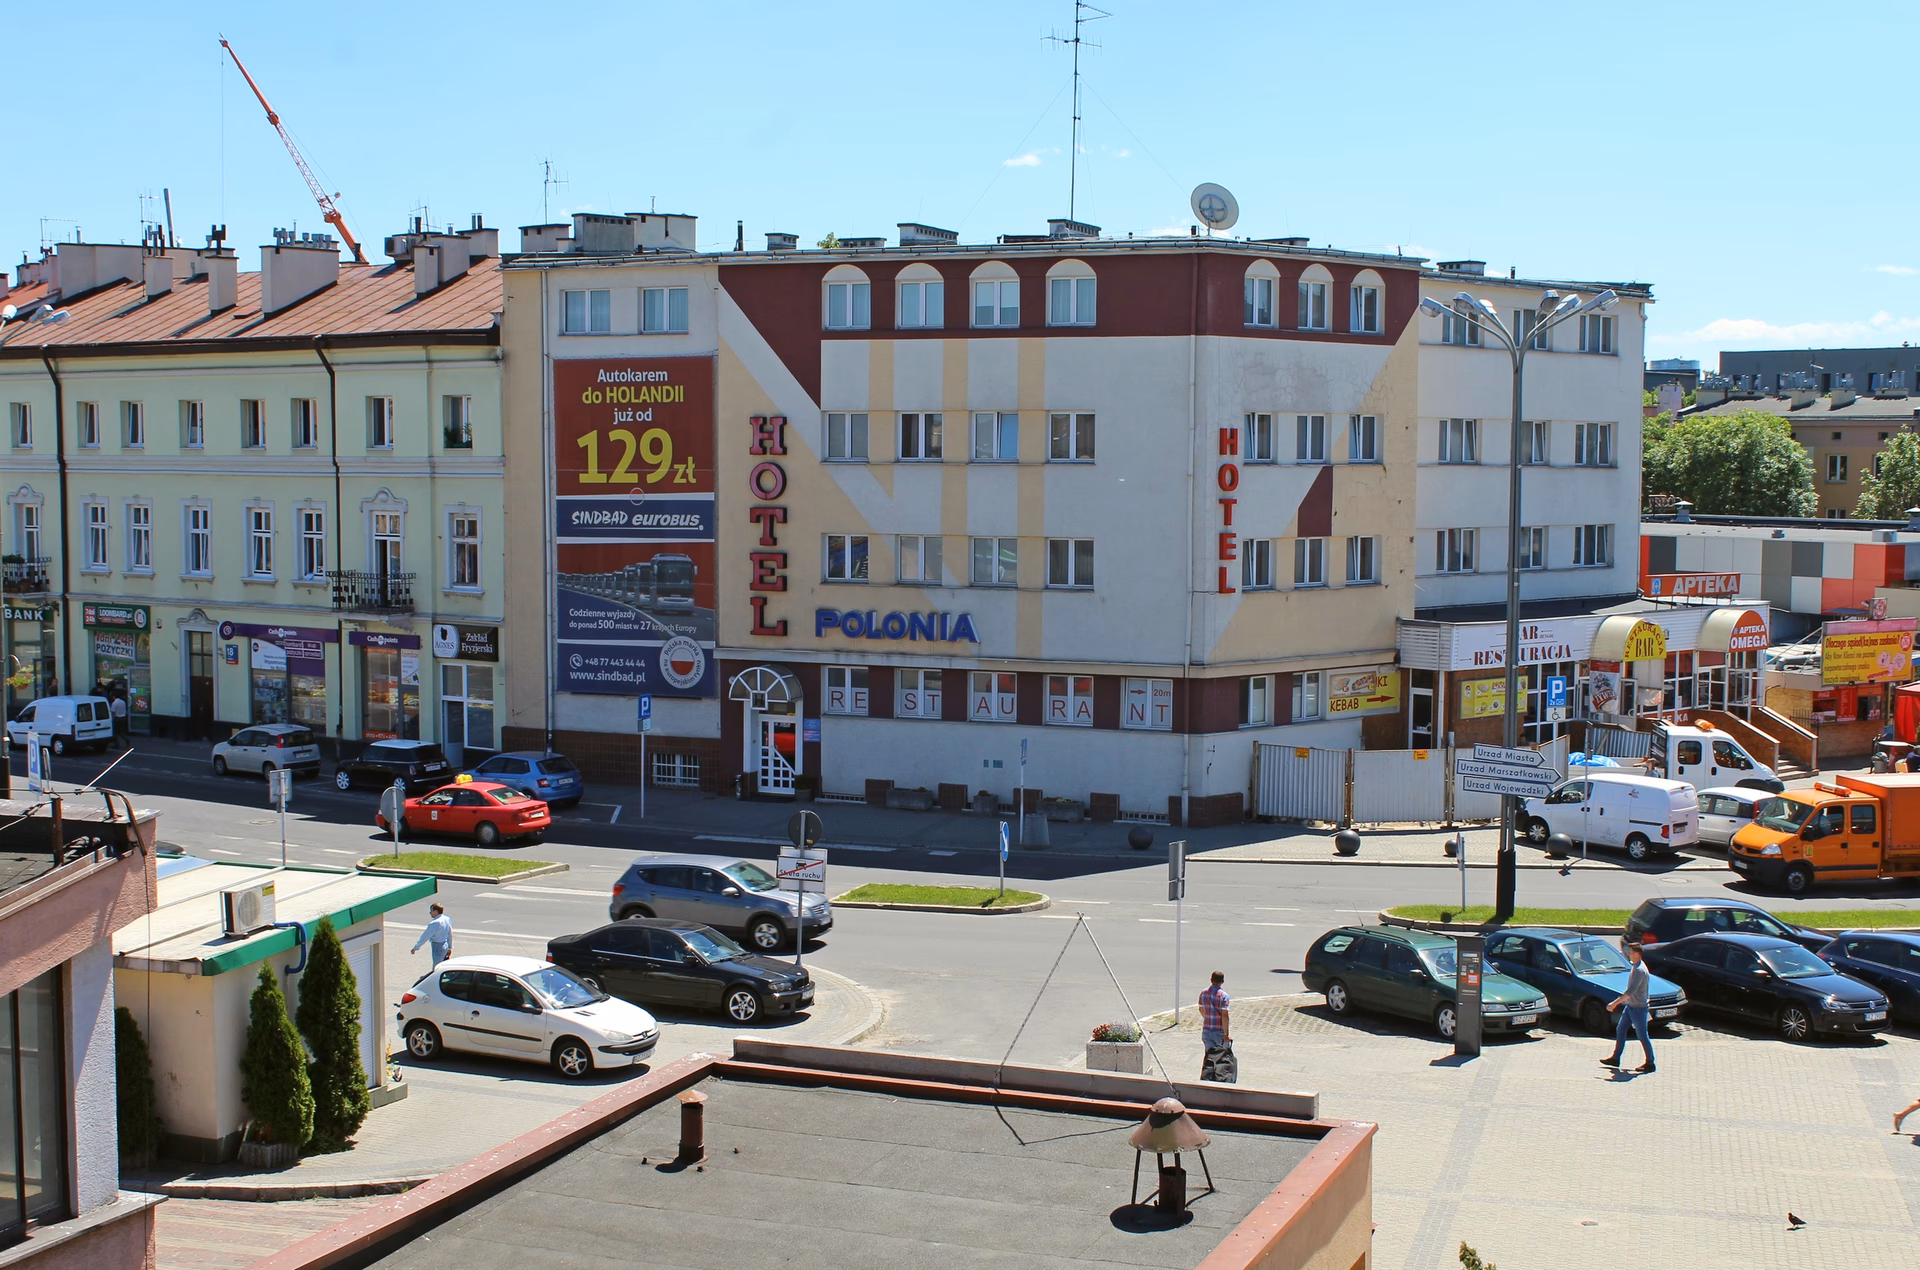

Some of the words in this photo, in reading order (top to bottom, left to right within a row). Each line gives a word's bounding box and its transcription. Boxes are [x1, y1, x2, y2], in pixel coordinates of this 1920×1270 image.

[597, 368, 668, 382] Autokarem
[582, 387, 602, 404] do
[606, 386, 684, 403] HOLANDII
[613, 408, 633, 424] już
[636, 408, 652, 421] od
[571, 511, 629, 525] SINDBAD
[1218, 428, 1239, 594] HOTEL
[750, 416, 787, 636] HOTEL
[1672, 575, 1738, 594] APTEKA
[4, 608, 44, 620] BANK
[569, 608, 606, 618] Codzienne
[607, 611, 636, 620] wyjazdy
[578, 621, 598, 630] ponad
[598, 619, 614, 629] 500
[615, 622, 632, 630] miast
[640, 621, 651, 630] 27
[652, 623, 674, 632] krajach
[675, 624, 697, 633] Europy
[815, 608, 981, 643] POLONIA
[1739, 625, 1765, 634] APTEKA
[466, 632, 488, 642] Zakład
[1624, 622, 1664, 659] RESTAURACJA
[1730, 634, 1768, 649] OMEGA
[227, 648, 234, 656] 18
[435, 641, 455, 650] AGNES
[461, 643, 493, 654] Fryzjerski
[664, 640, 682, 656] Polska
[683, 640, 700, 657] marka
[1635, 637, 1654, 657] BAR
[585, 658, 599, 666] +48
[600, 658, 608, 666] 77
[610, 658, 623, 667] 443
[625, 659, 635, 667] 44
[636, 659, 646, 667] 44
[570, 671, 646, 684] www.sindbad.pl
[665, 667, 695, 687] europejskim
[1153, 688, 1171, 697] 20m
[1552, 680, 1563, 698] P
[641, 697, 649, 716] P
[1330, 697, 1359, 712] KEBAB
[30, 743, 36, 769] P
[1477, 748, 1502, 759] Urząd
[1505, 752, 1535, 763] Miasta
[1460, 763, 1485, 774] Urząd
[1488, 766, 1552, 780] Marszałkowski
[1466, 780, 1491, 791] Urząd
[1493, 782, 1544, 795] Wojewódzki
